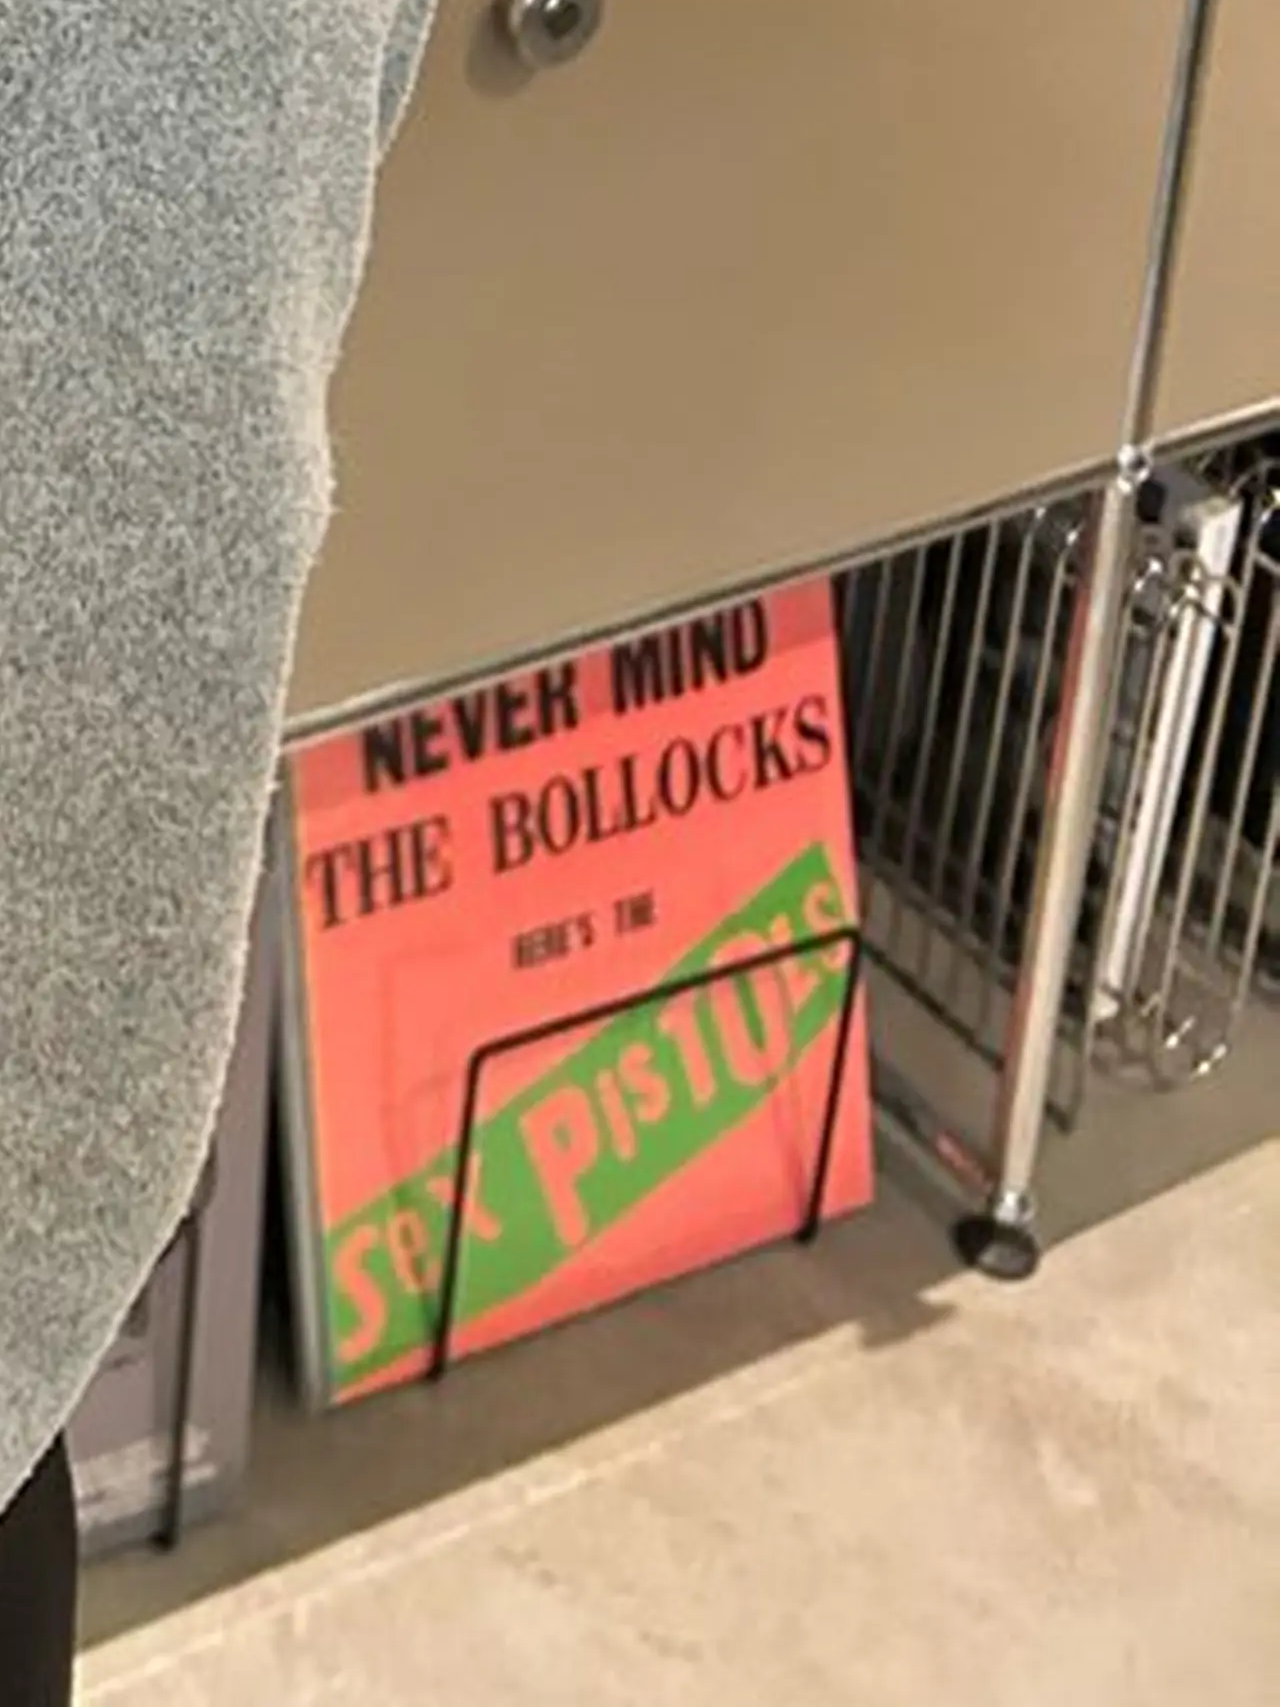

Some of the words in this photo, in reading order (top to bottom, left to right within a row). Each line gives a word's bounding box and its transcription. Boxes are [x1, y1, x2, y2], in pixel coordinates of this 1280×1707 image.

[360, 661, 578, 793] NEVER
[608, 597, 769, 714] MIND
[304, 815, 452, 931] THE
[487, 695, 831, 875] BOLLOCKS
[614, 890, 658, 932] THE
